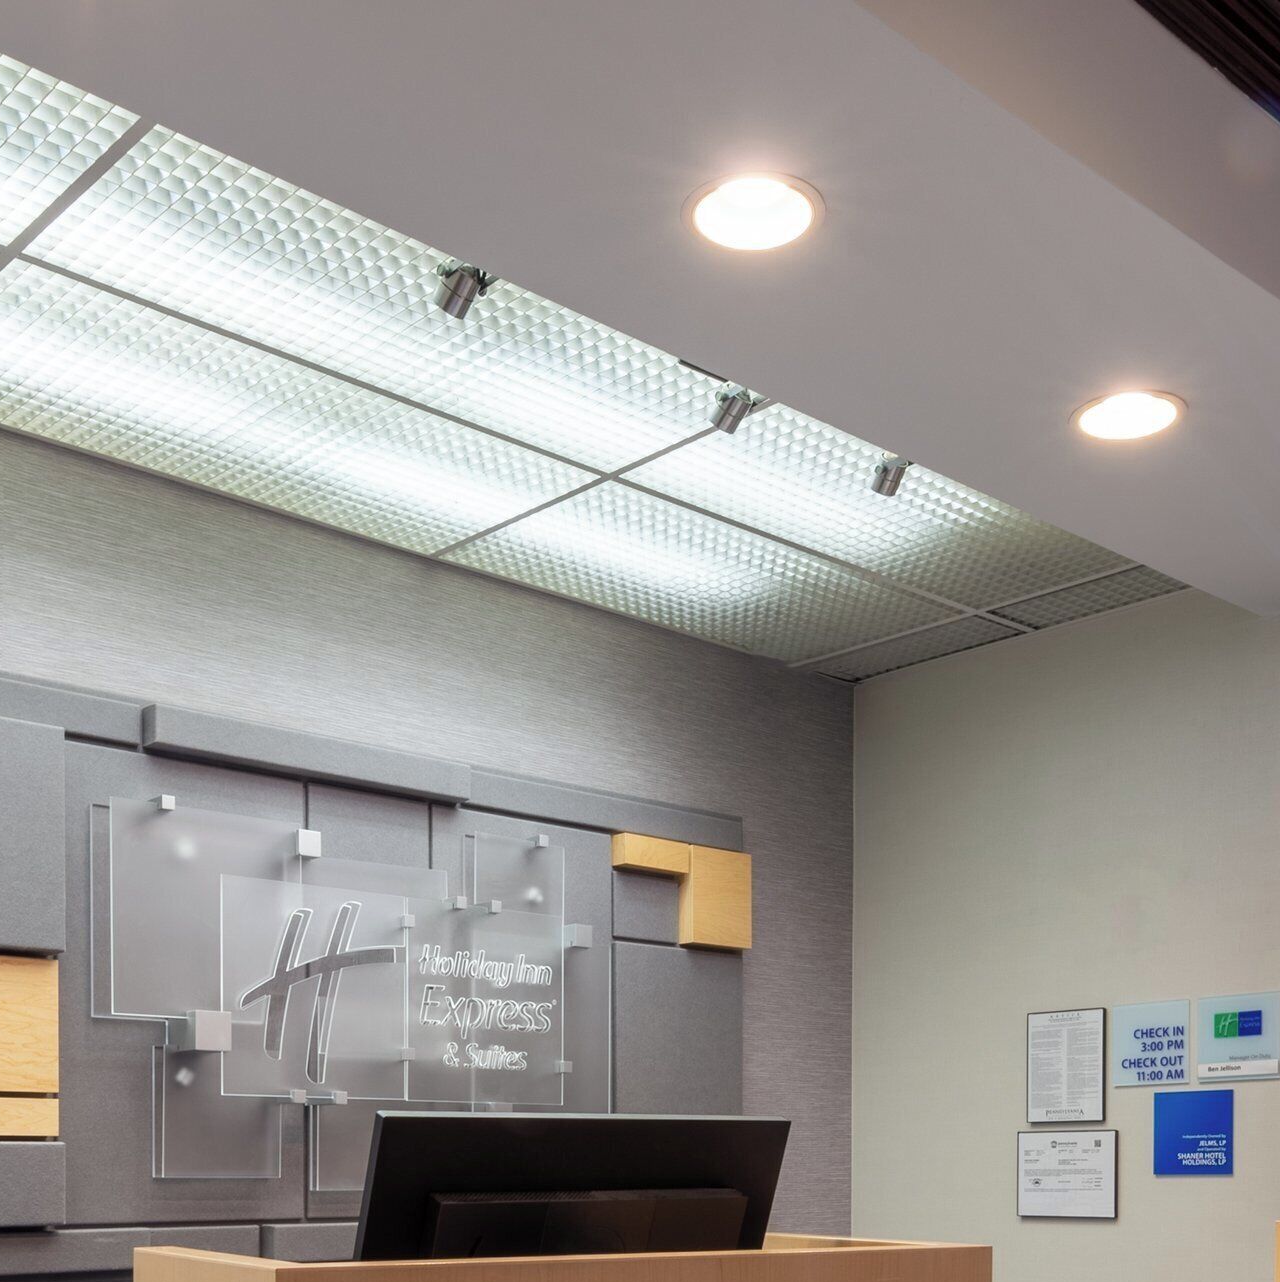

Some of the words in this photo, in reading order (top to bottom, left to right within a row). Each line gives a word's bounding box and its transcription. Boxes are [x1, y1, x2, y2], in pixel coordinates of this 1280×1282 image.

[419, 944, 514, 988] Holiday
[516, 953, 553, 985] Inn
[419, 984, 553, 1039] Express
[1133, 1026, 1170, 1039] CHECK
[1172, 1026, 1184, 1036] IN
[1140, 1041, 1164, 1052] 3:00
[1167, 1039, 1184, 1050] PM
[442, 1042, 460, 1067] &
[464, 1042, 528, 1070] Suites
[1121, 1057, 1157, 1069] CHECK
[1160, 1055, 1184, 1066] OUT
[1137, 1071, 1163, 1081] 11:00
[1166, 1069, 1184, 1080] AM
